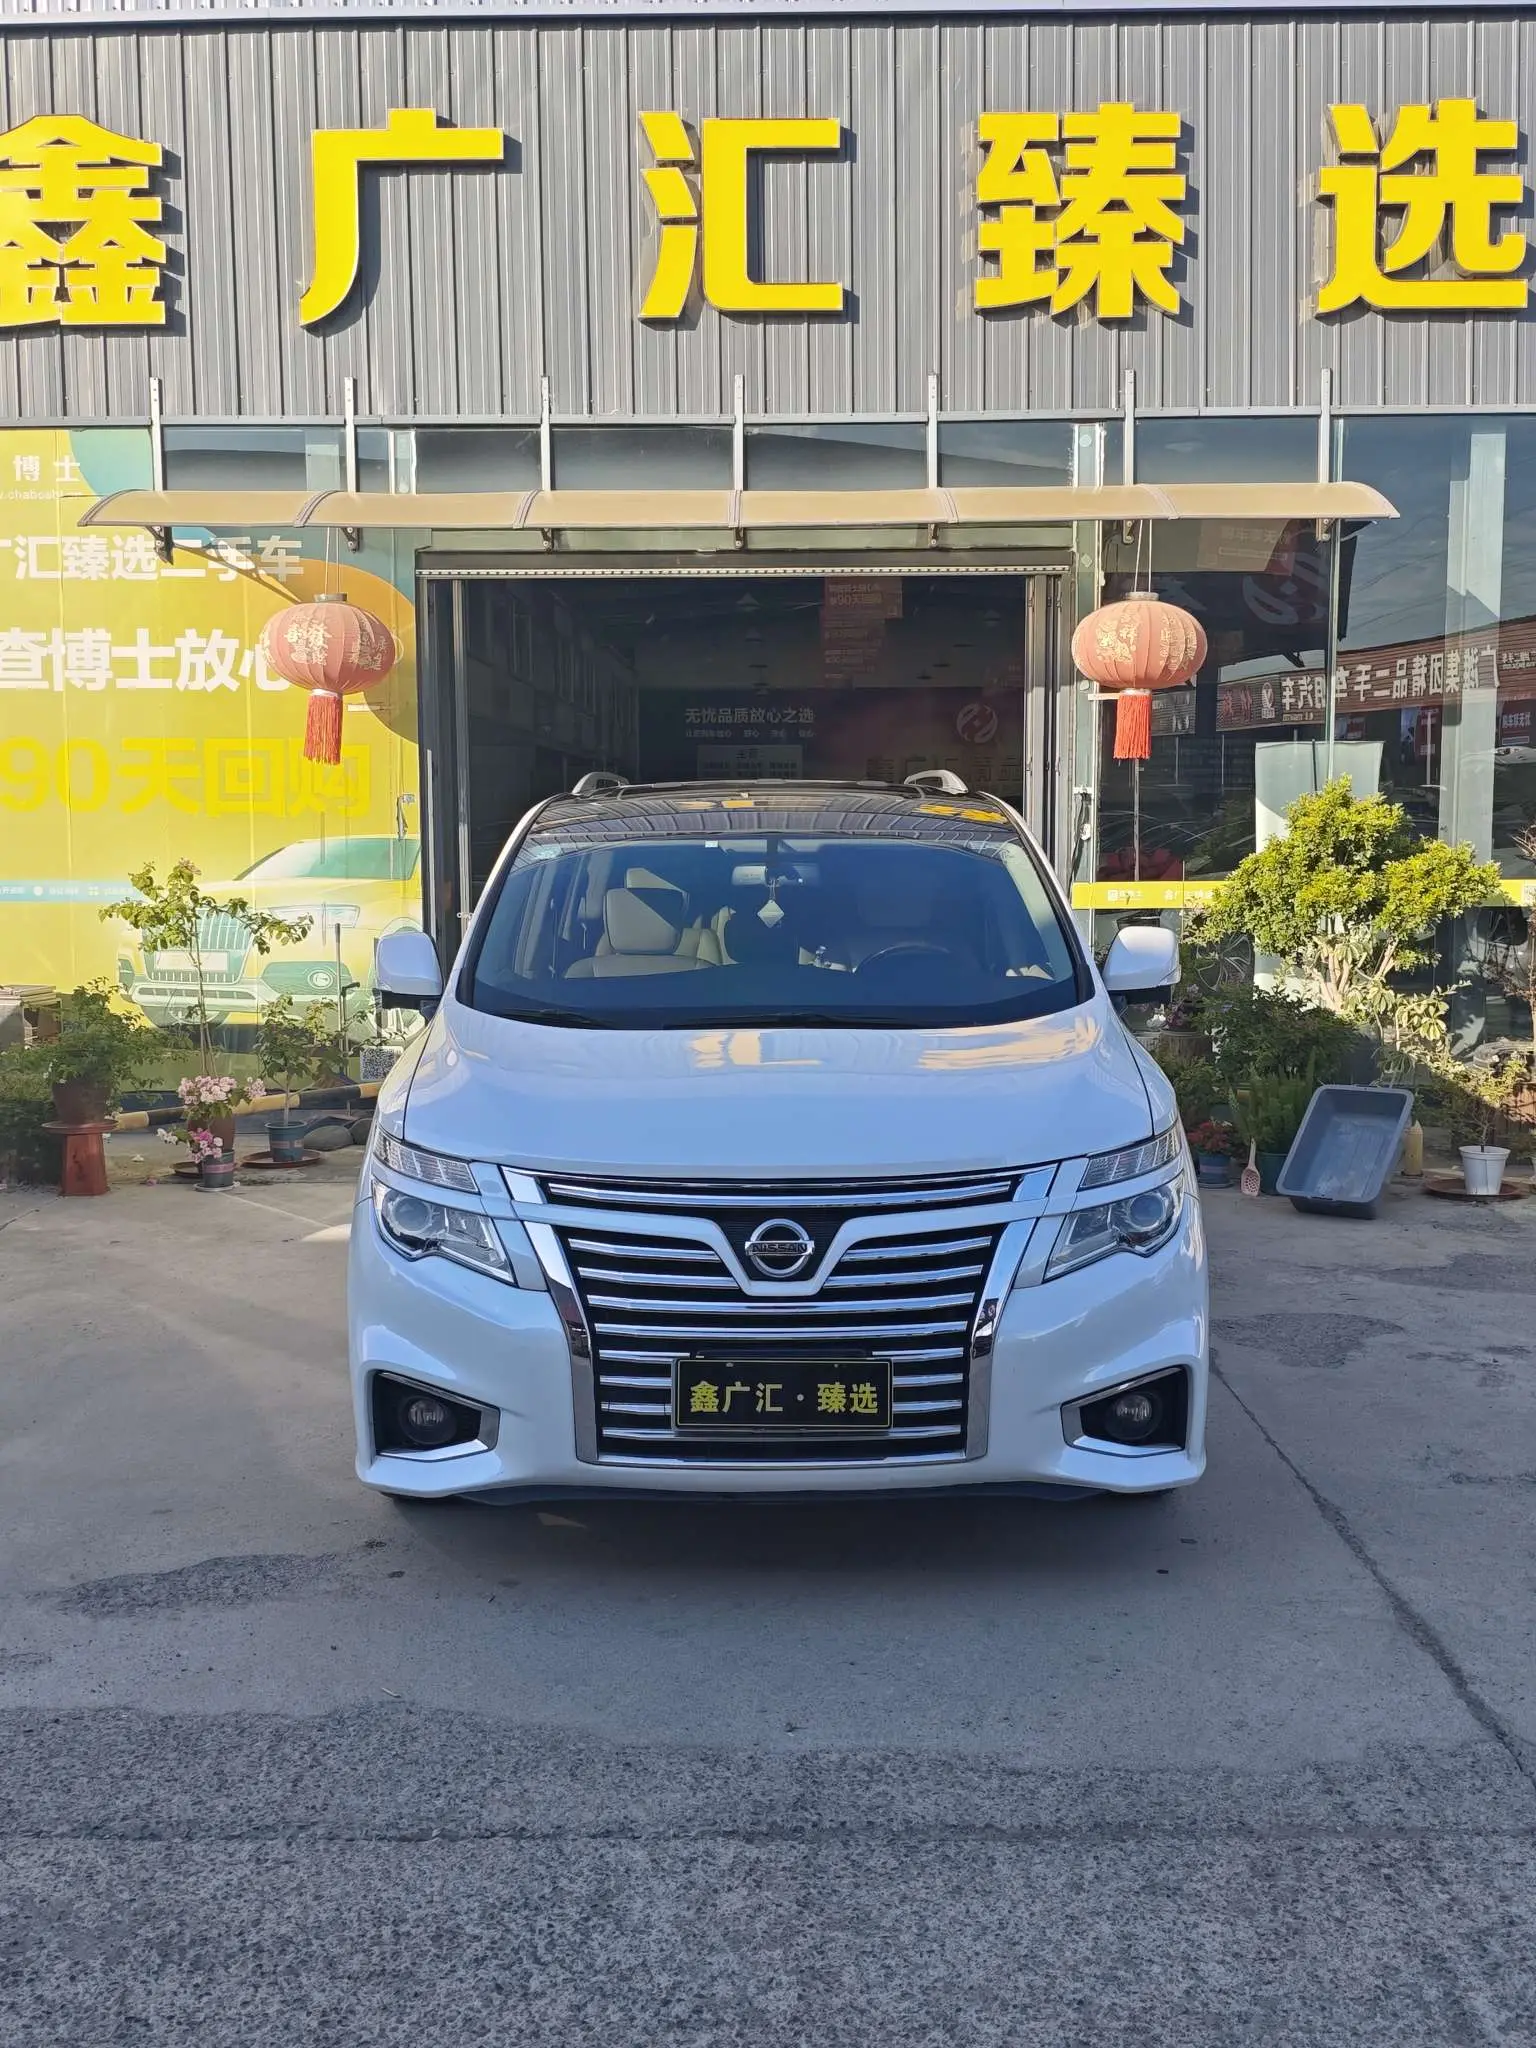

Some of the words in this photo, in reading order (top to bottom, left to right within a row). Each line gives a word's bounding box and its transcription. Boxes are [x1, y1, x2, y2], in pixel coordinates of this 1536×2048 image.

[0, 98, 1528, 329] 鑫广汇臻选
[0, 535, 304, 582] 汇臻选二手车
[751, 1242, 809, 1253] NISSAN
